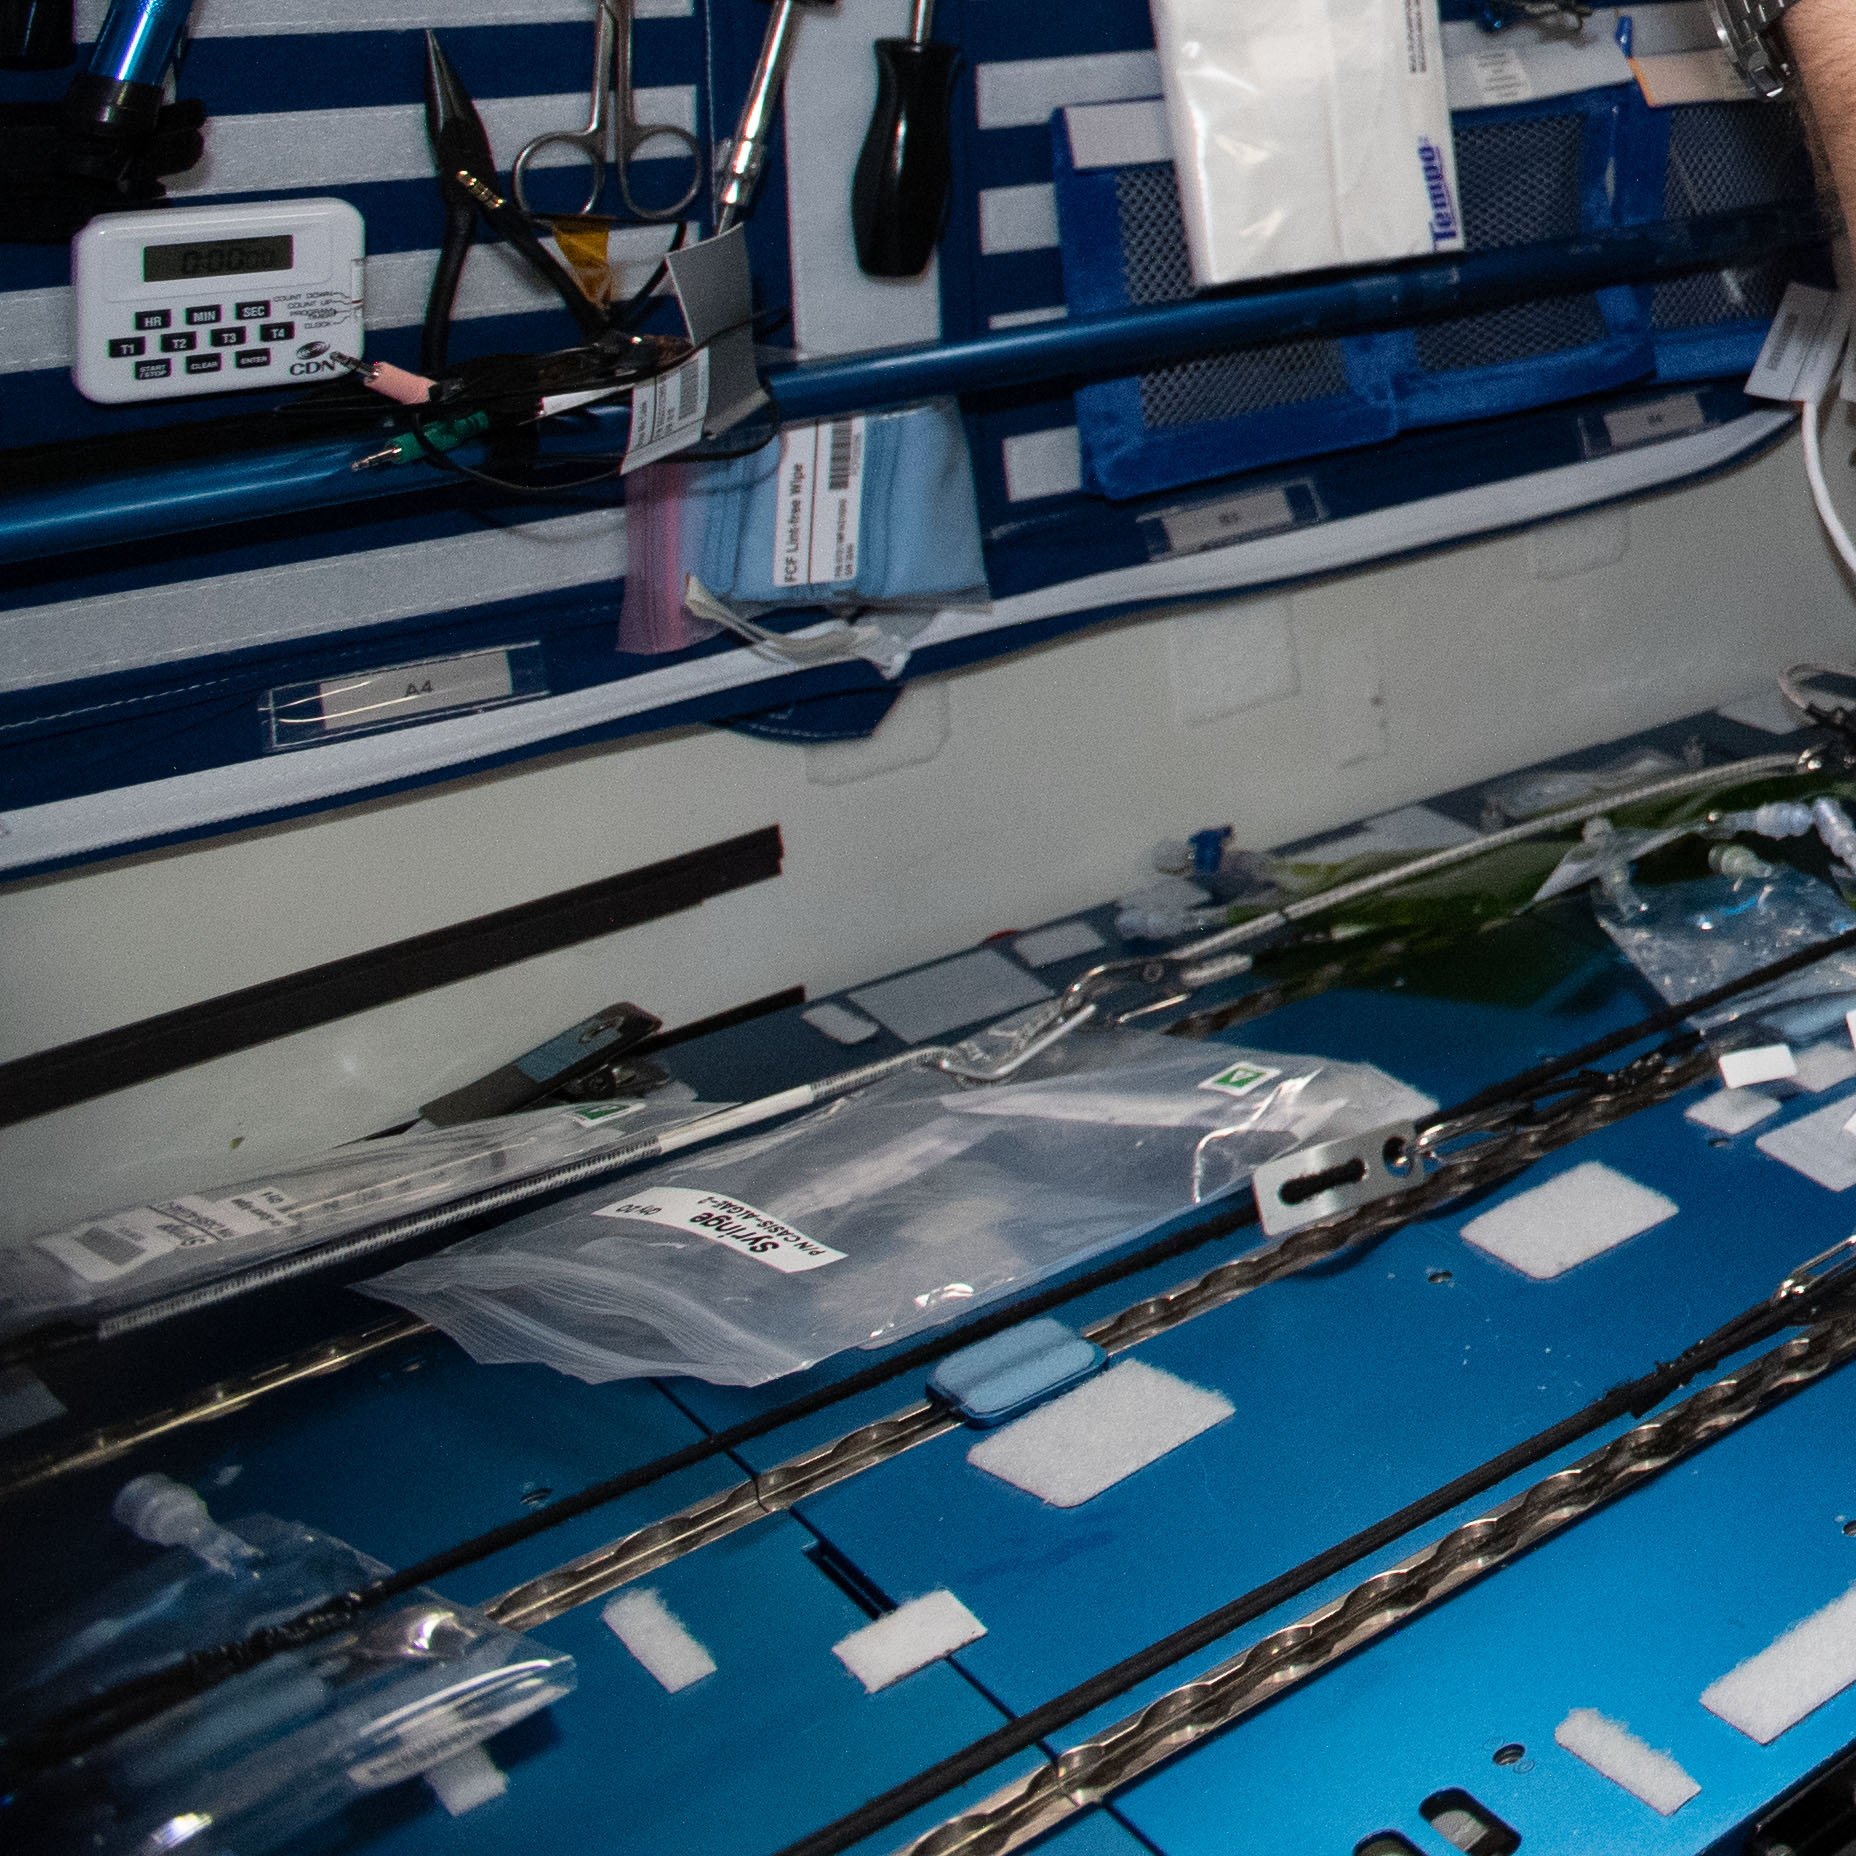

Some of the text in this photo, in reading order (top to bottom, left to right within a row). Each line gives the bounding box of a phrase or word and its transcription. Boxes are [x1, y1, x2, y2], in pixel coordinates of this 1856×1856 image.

[1416, 143, 1458, 253] Tempo
[144, 305, 266, 328] HR MIN SEC
[120, 327, 286, 355] T1 T2 T3 T4
[190, 360, 219, 370] CLEAR
[240, 355, 268, 366] ENTER
[289, 359, 336, 376] CDN
[784, 462, 806, 583] FCF Lint-free Wipe
[404, 679, 434, 697] A4
[688, 1211, 780, 1254] Syringe
[796, 1241, 827, 1256] P/N
